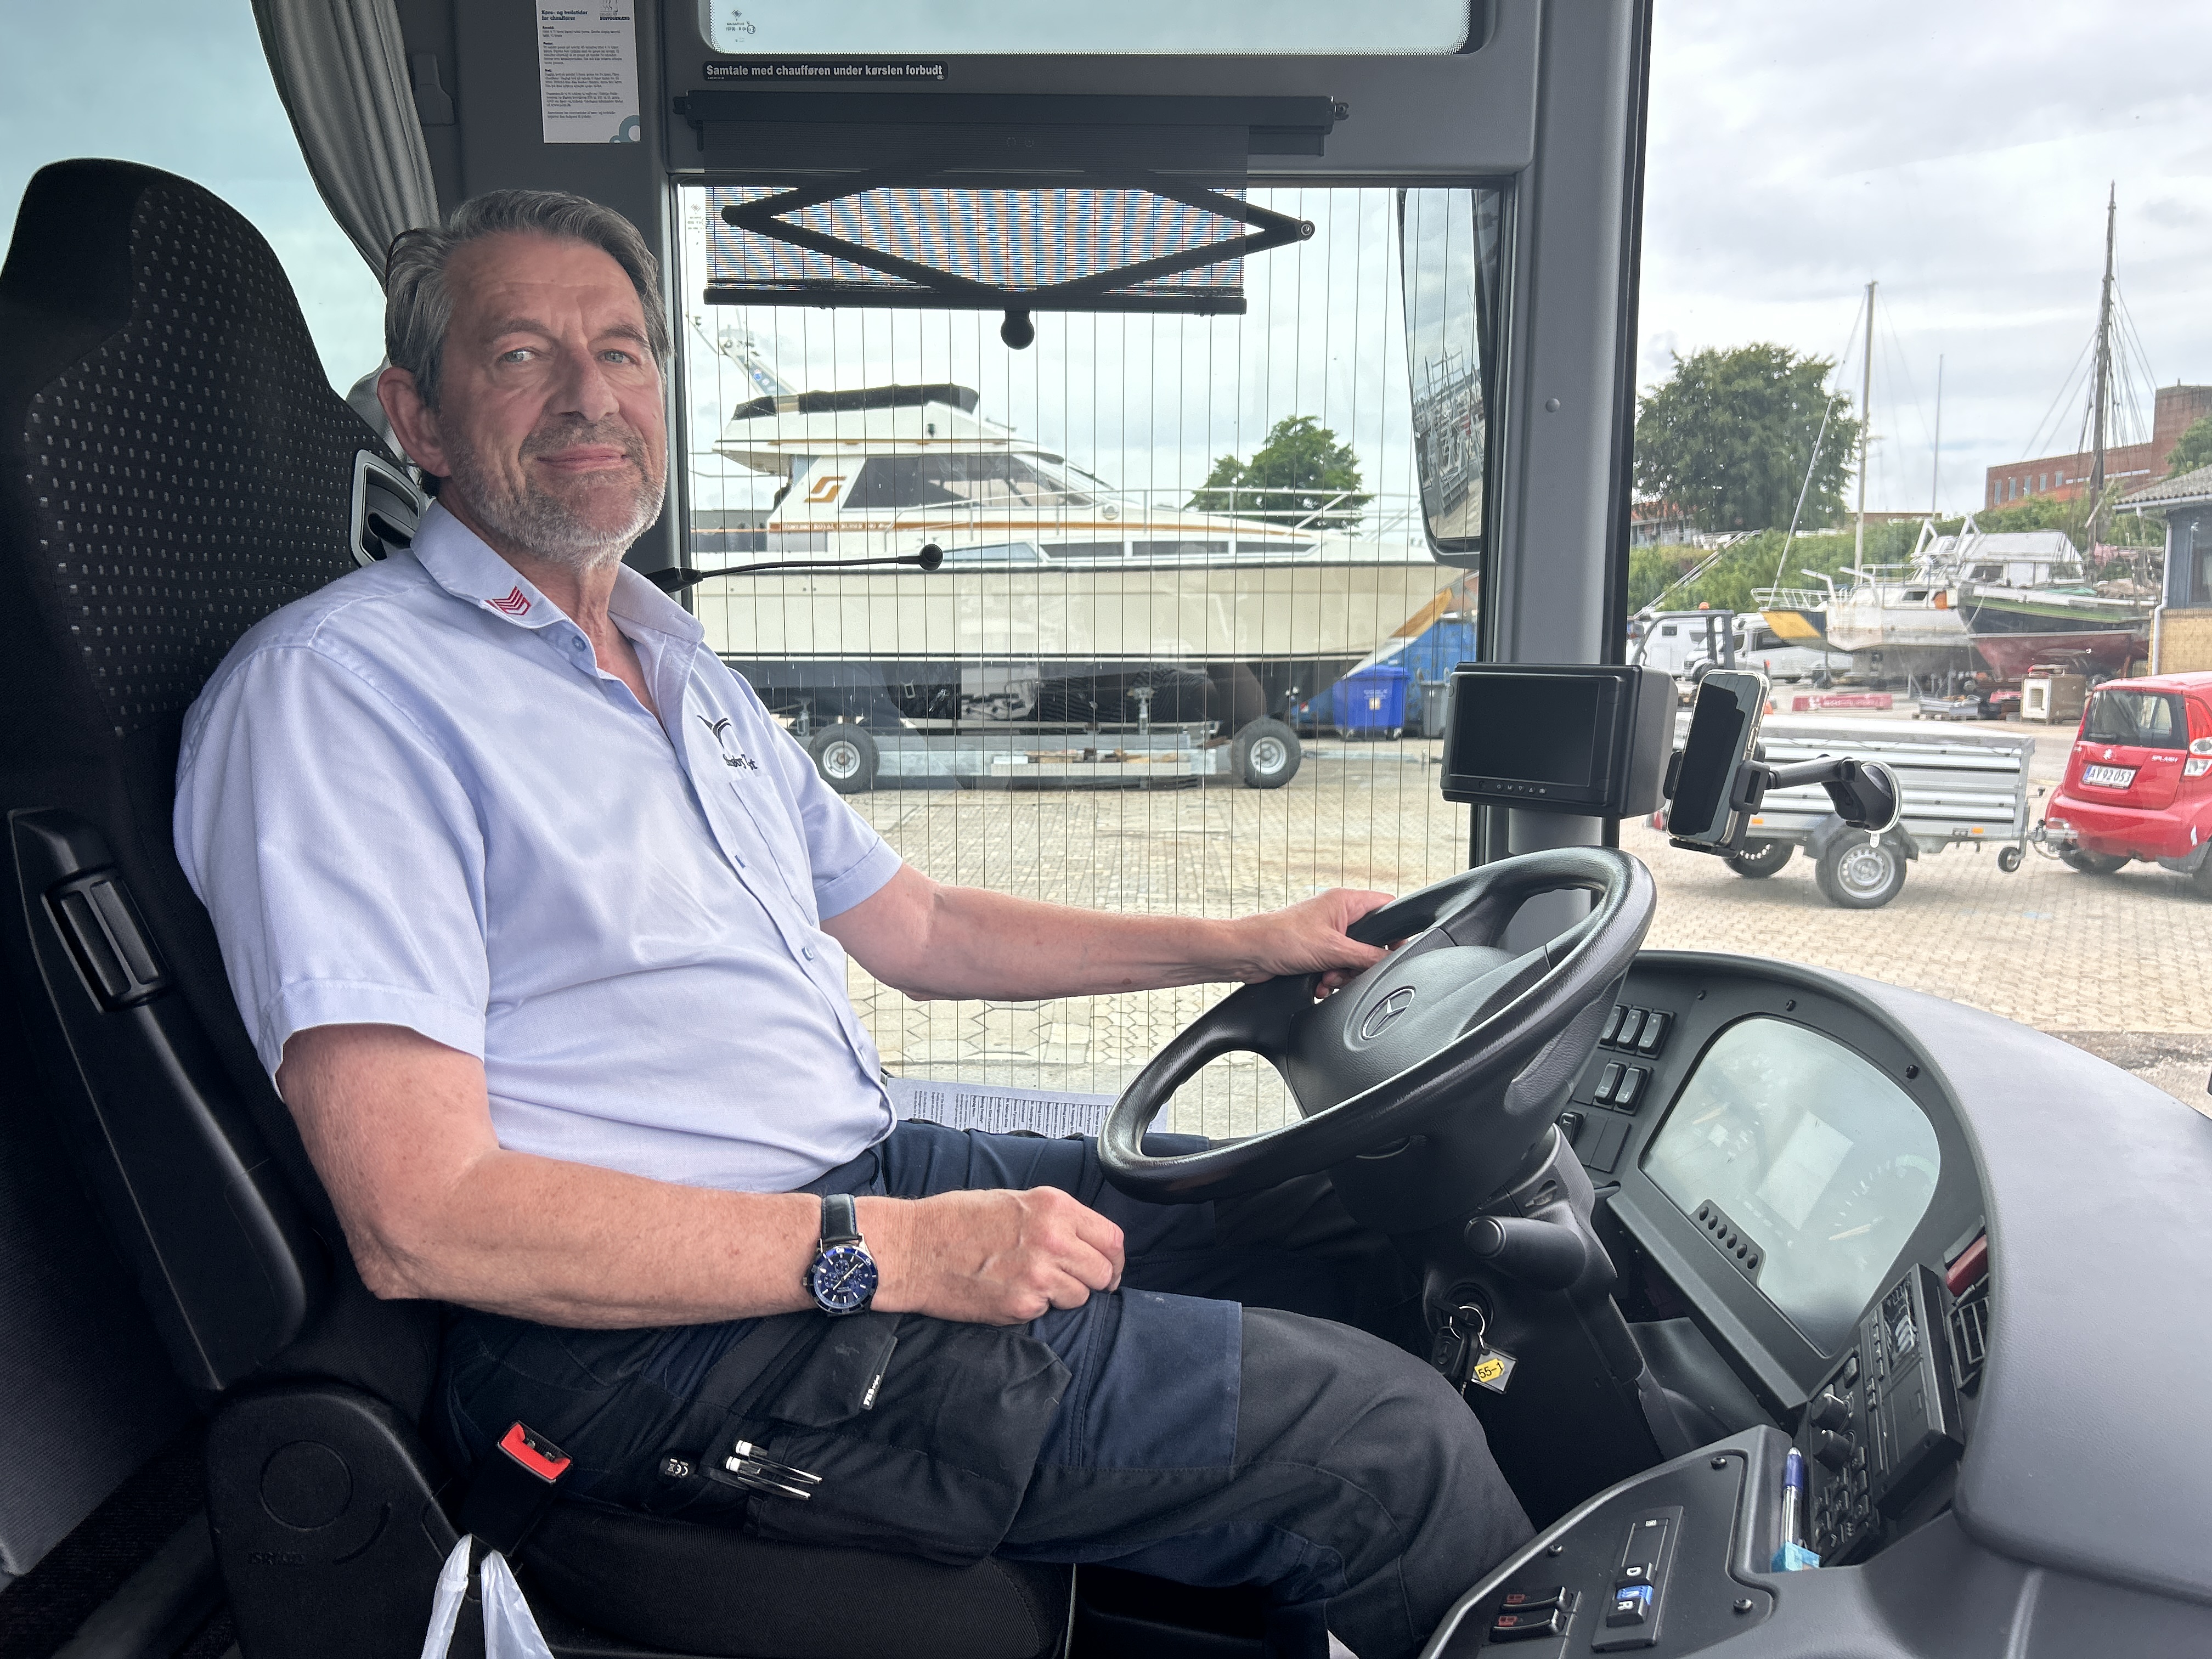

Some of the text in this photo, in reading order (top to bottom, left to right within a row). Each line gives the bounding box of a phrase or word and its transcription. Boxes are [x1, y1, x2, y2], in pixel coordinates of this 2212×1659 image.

[706, 65, 943, 75] Samtale med chaufføren under kørslen forbudt
[1478, 1362, 1503, 1378] 55-1
[1626, 1567, 1643, 1577] D
[1617, 1600, 1634, 1611] R
